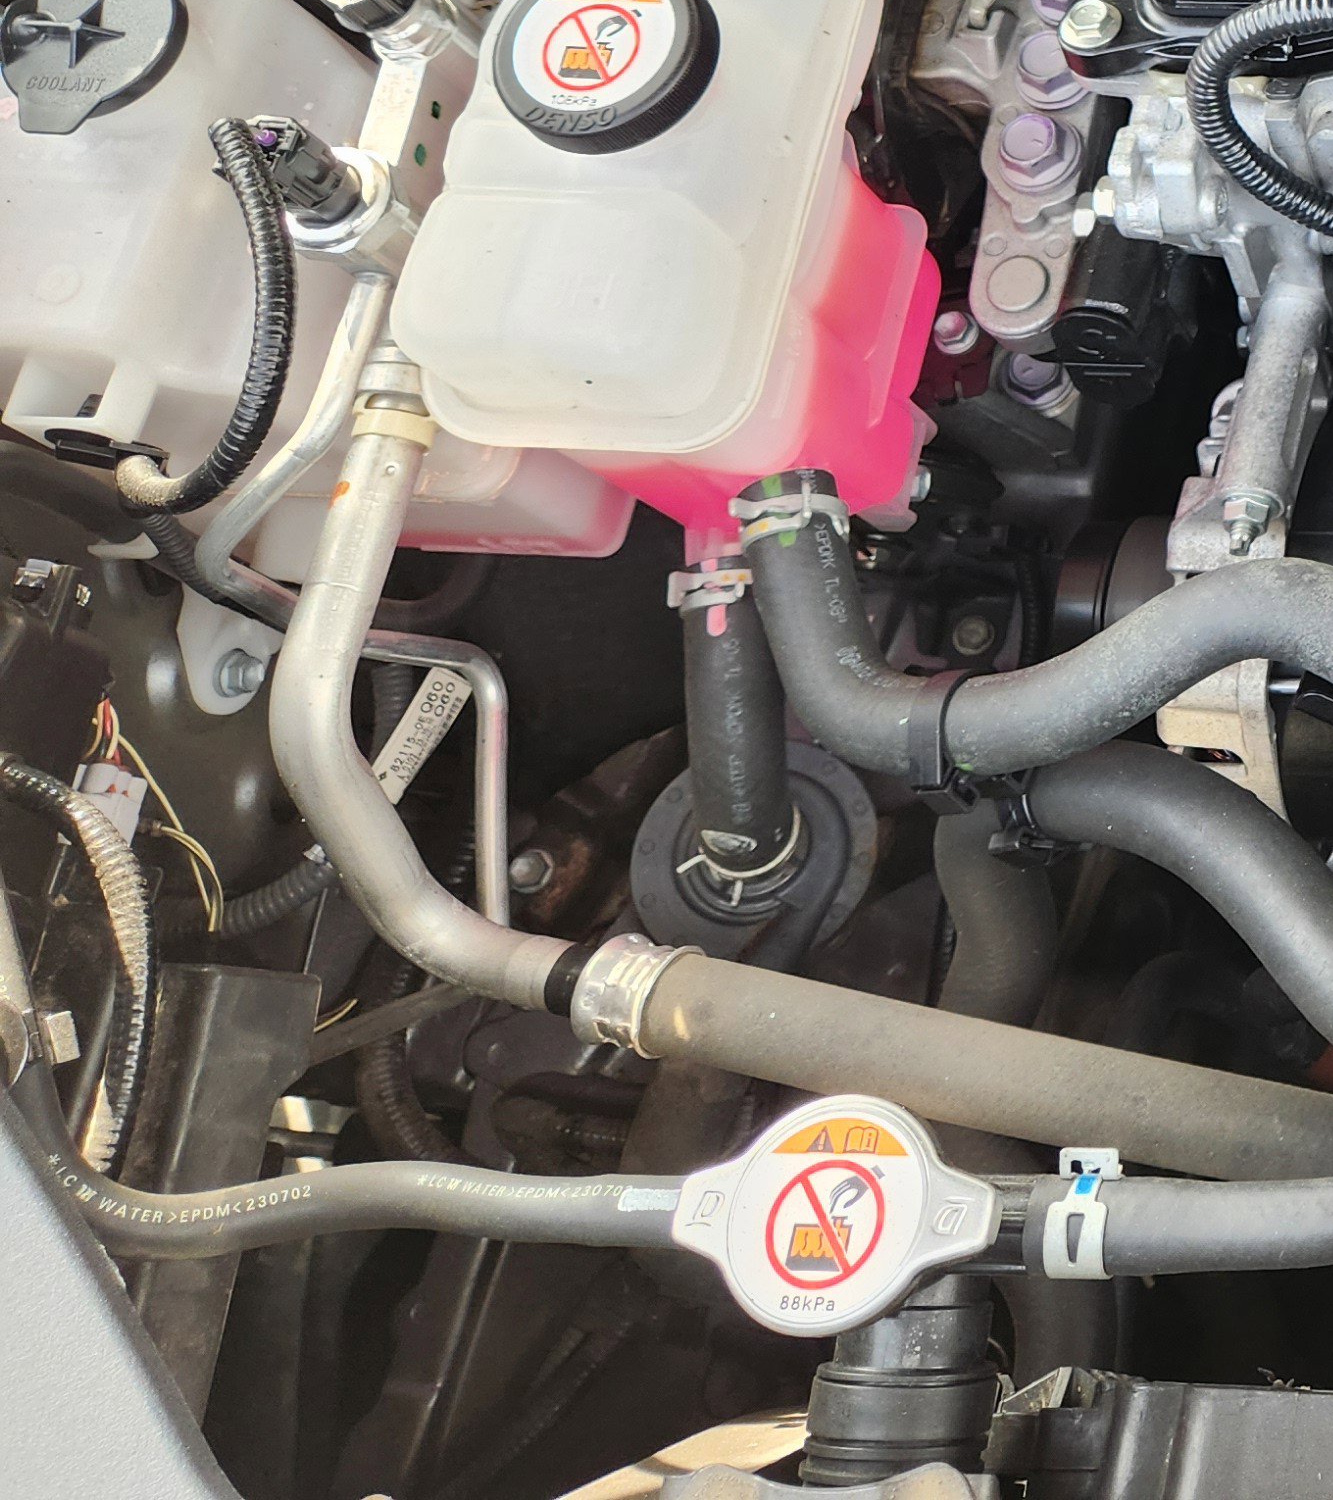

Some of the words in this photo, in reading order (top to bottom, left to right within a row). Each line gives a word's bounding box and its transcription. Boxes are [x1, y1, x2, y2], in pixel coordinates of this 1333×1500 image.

[25, 76, 106, 92] COOLANT
[525, 105, 617, 132] DENSO
[779, 1295, 836, 1312] 88kPa
